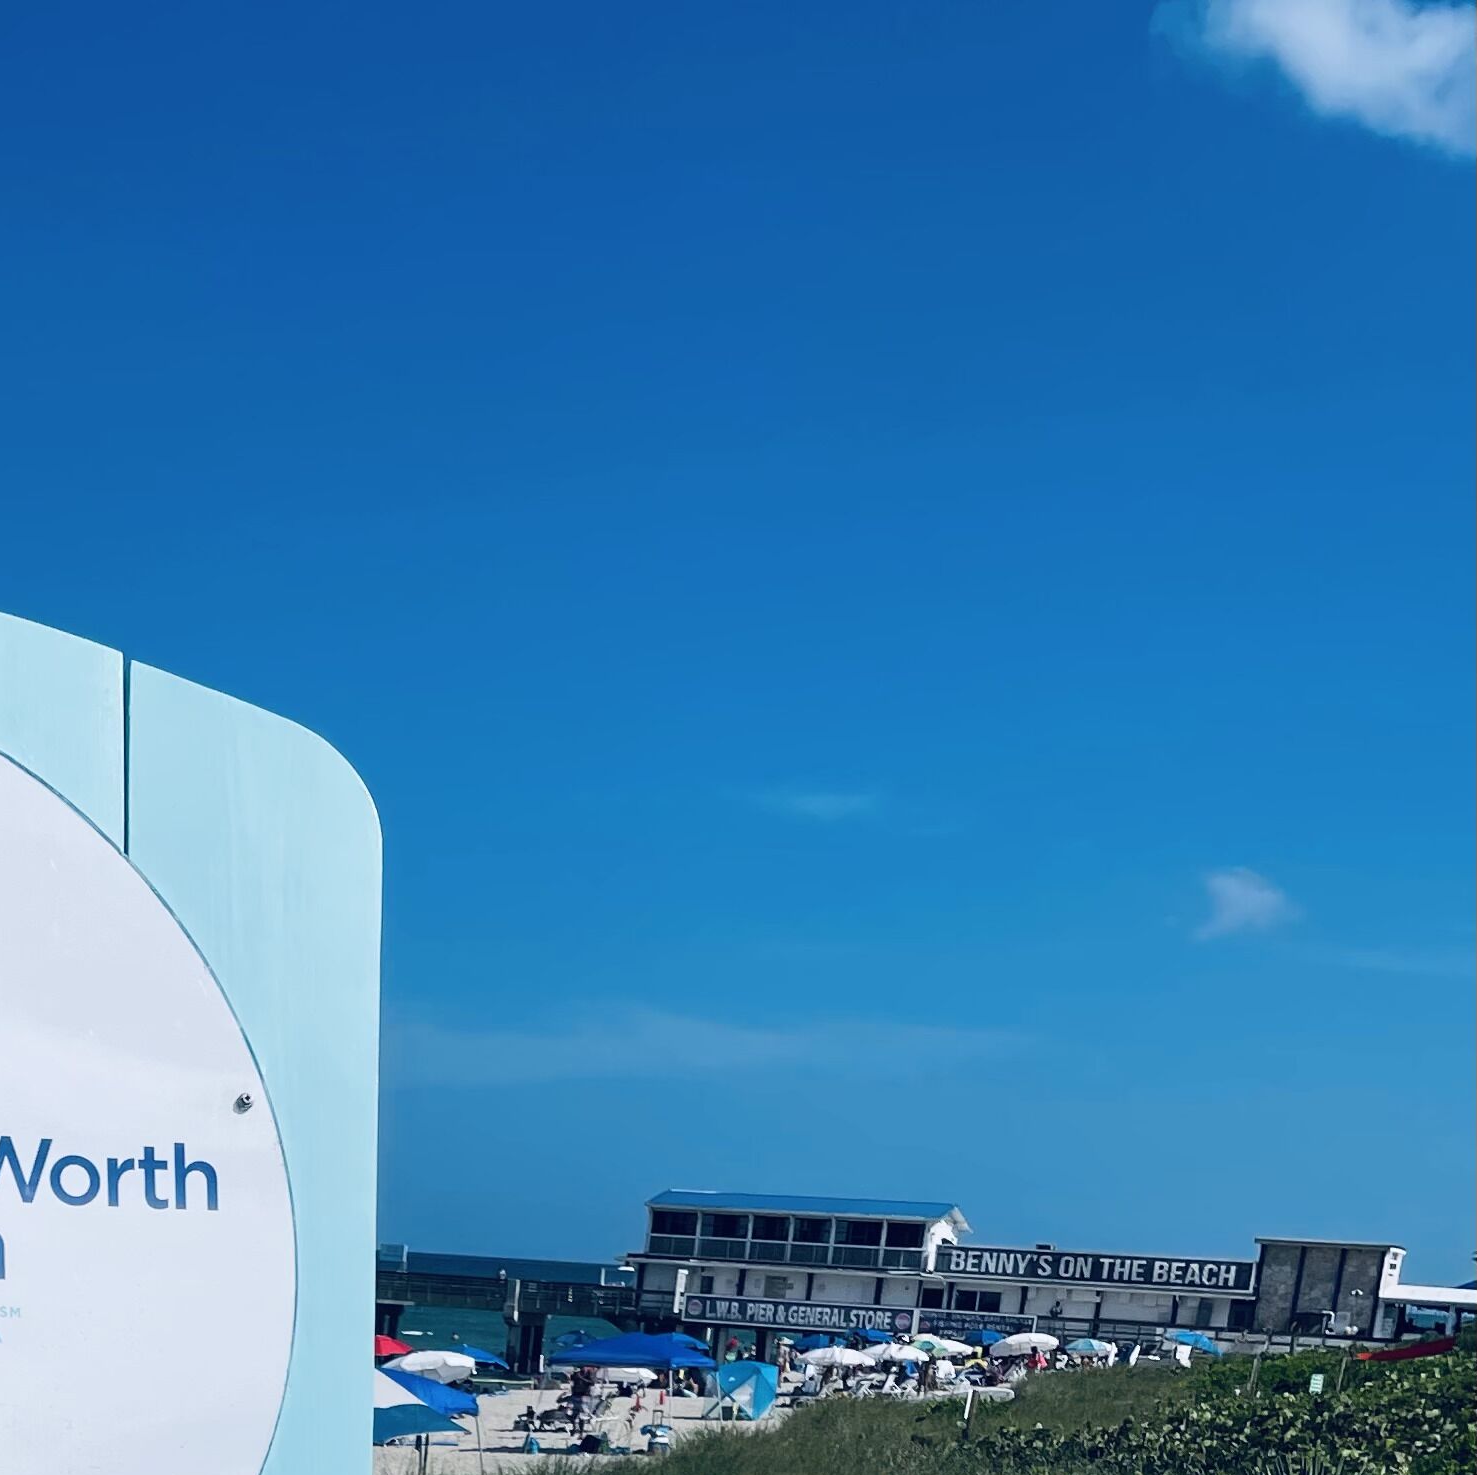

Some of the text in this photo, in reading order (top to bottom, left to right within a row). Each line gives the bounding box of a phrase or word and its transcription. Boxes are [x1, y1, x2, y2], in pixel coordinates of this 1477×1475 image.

[949, 1249, 1237, 1288] BENNY'S ON THE BEACH
[705, 1300, 893, 1330] L.W.B. PIER & GENERAL STORE
